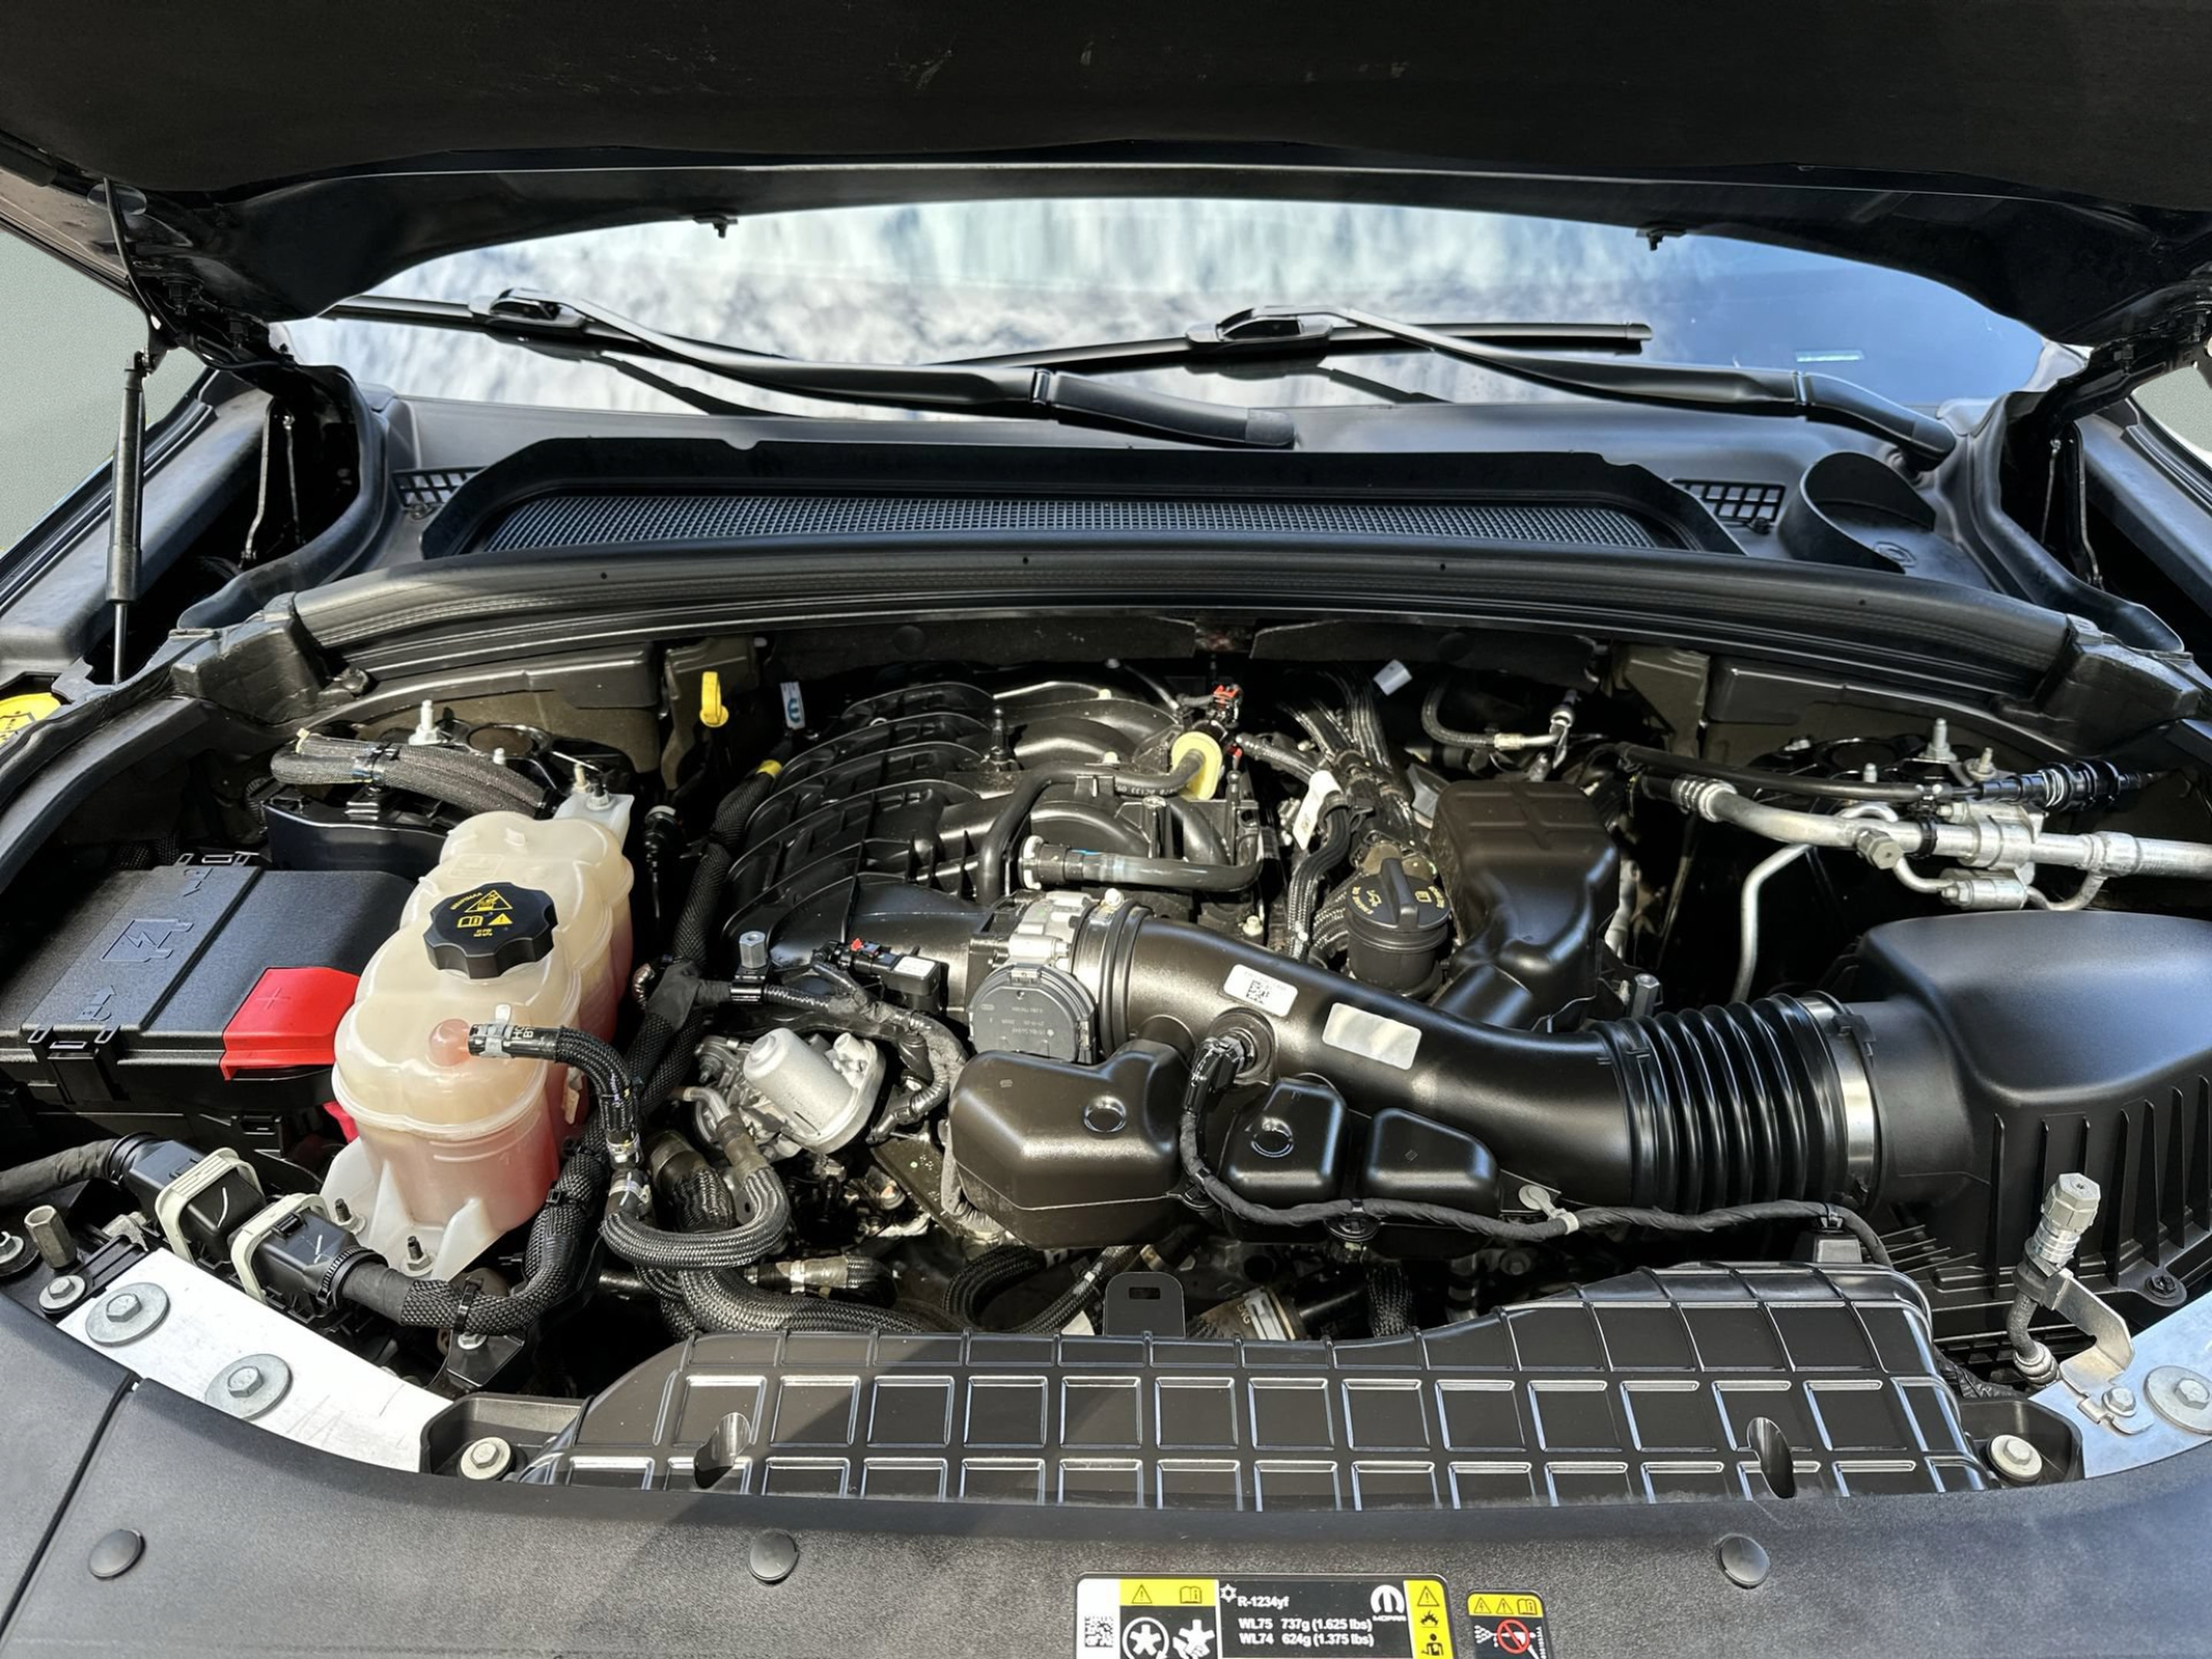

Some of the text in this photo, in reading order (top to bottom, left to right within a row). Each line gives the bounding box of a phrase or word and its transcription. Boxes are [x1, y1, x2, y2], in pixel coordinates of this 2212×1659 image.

[1237, 1595, 1290, 1610] R-1234yf
[1238, 1618, 1373, 1632] WL75 737g (1.625 lbs)
[1239, 1632, 1375, 1648] WL74 624g (1.375 lbs)
